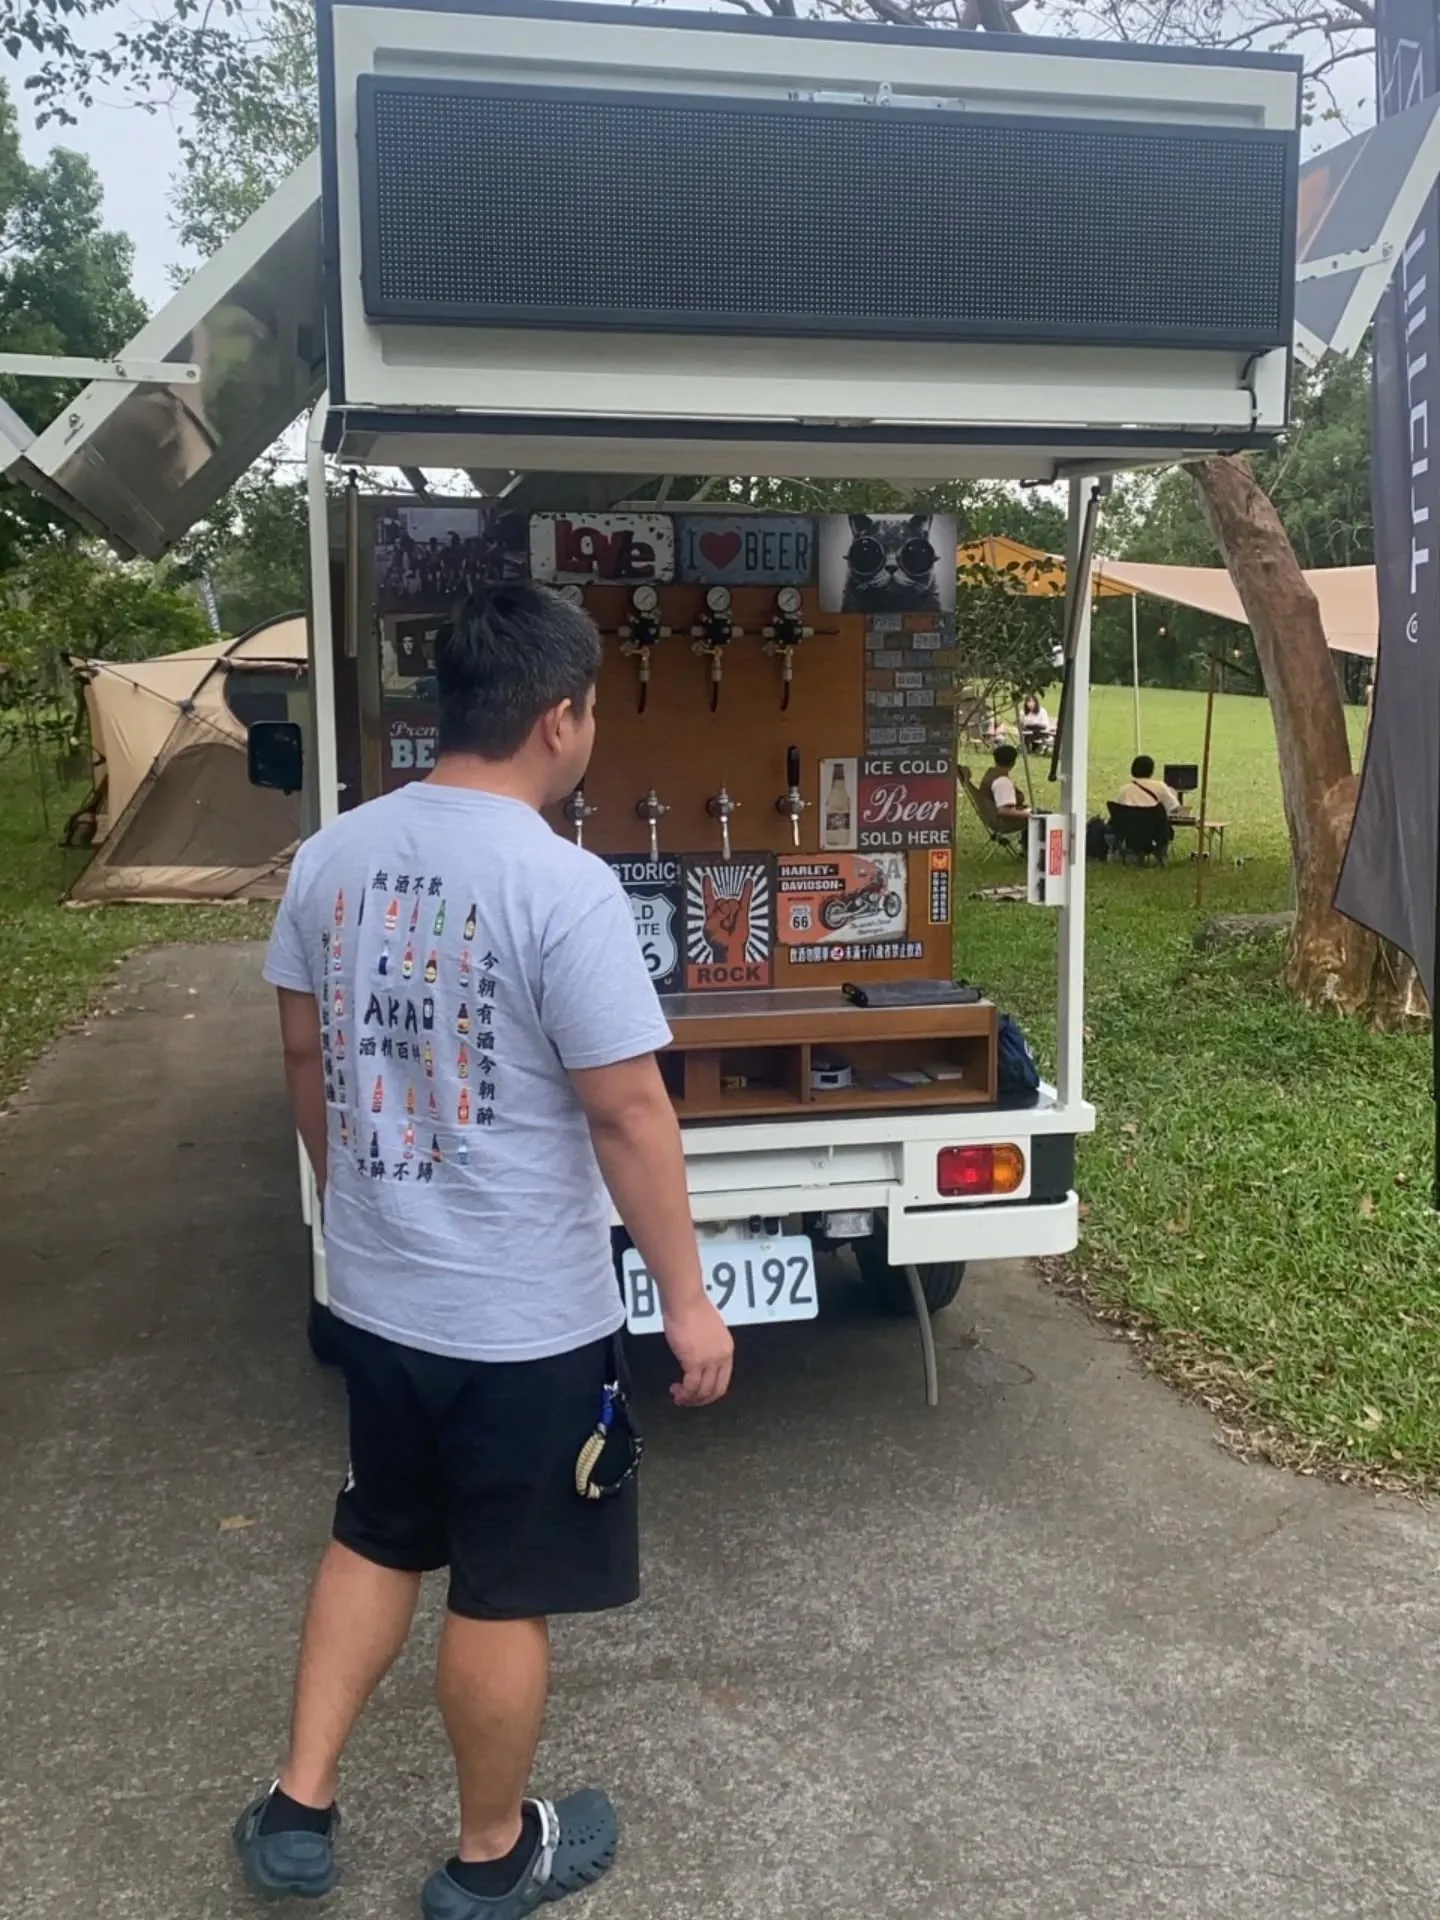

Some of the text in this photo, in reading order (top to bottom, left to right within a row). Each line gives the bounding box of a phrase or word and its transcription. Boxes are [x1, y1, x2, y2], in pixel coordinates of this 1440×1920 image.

[745, 531, 808, 572] BEER
[865, 760, 948, 775] ICE COLD
[863, 783, 949, 823] Beer
[860, 830, 950, 846] SOLD HERE
[793, 916, 809, 929] 66
[697, 965, 760, 984] ROCK
[476, 951, 500, 1126] 今朝有酒今朝醉
